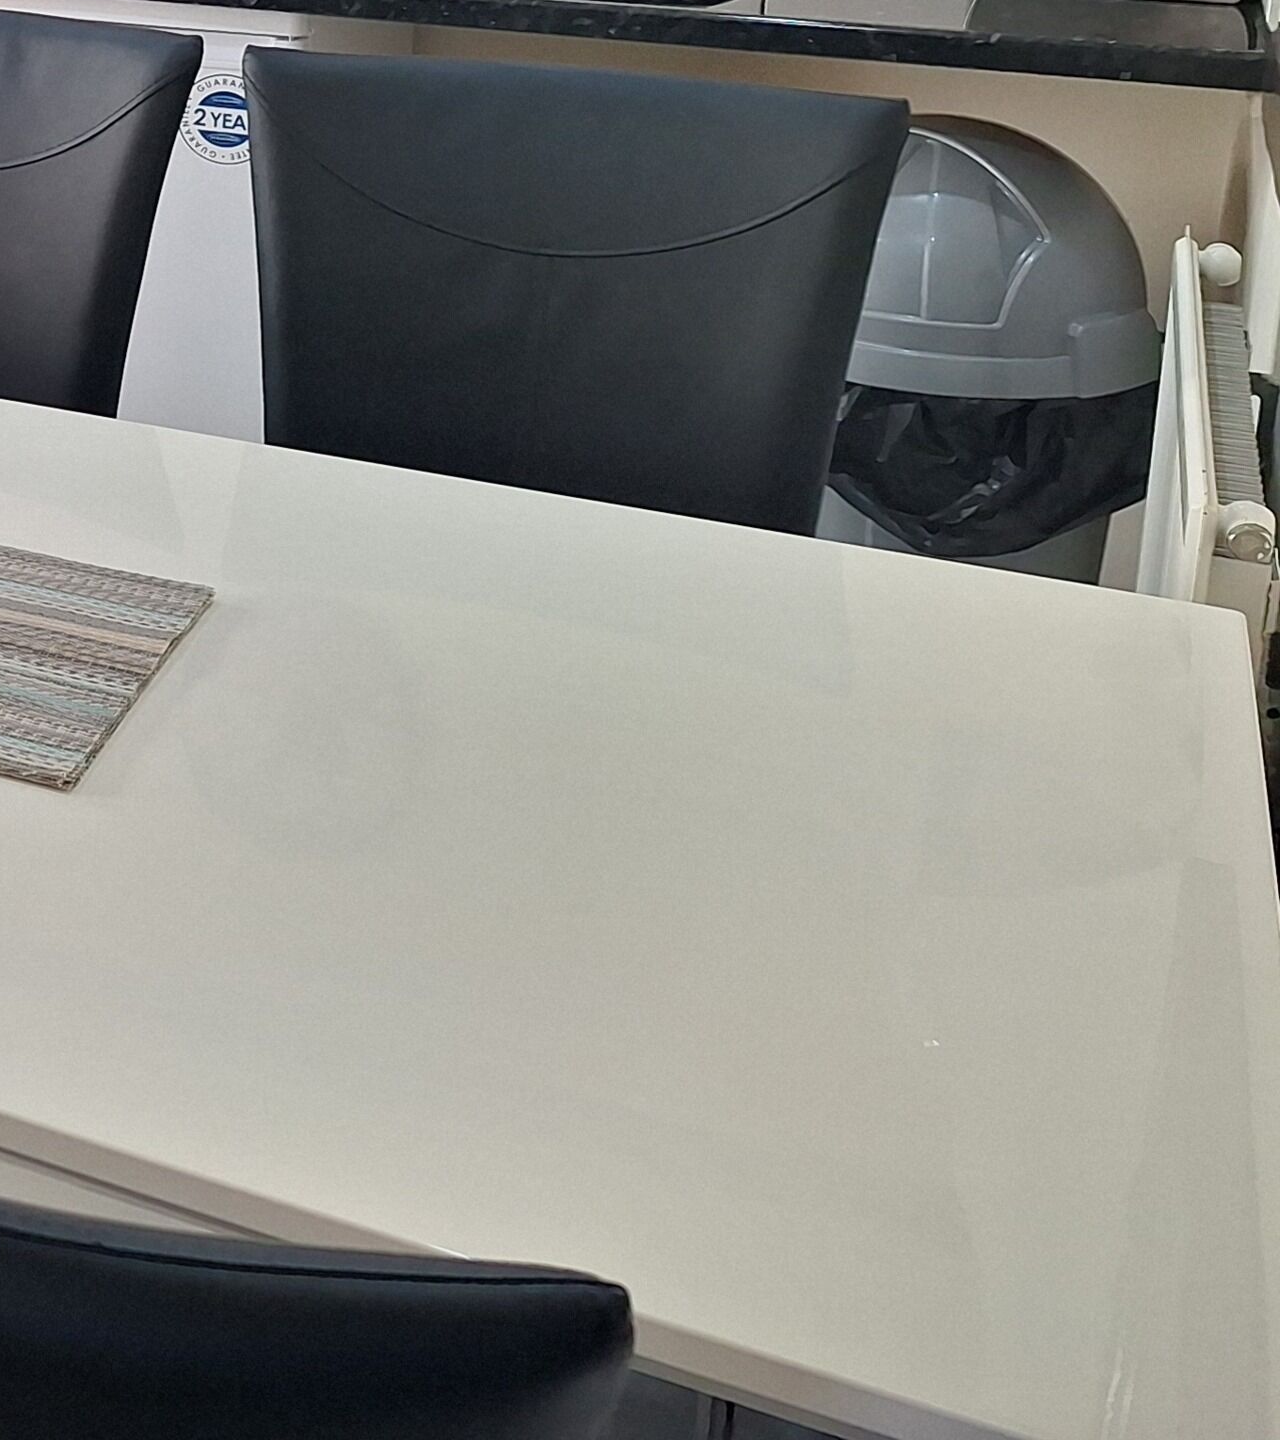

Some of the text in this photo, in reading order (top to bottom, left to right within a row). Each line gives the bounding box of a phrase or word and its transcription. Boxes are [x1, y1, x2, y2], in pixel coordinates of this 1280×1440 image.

[196, 78, 246, 92] GUARAN
[193, 108, 247, 131] 2 YEA
